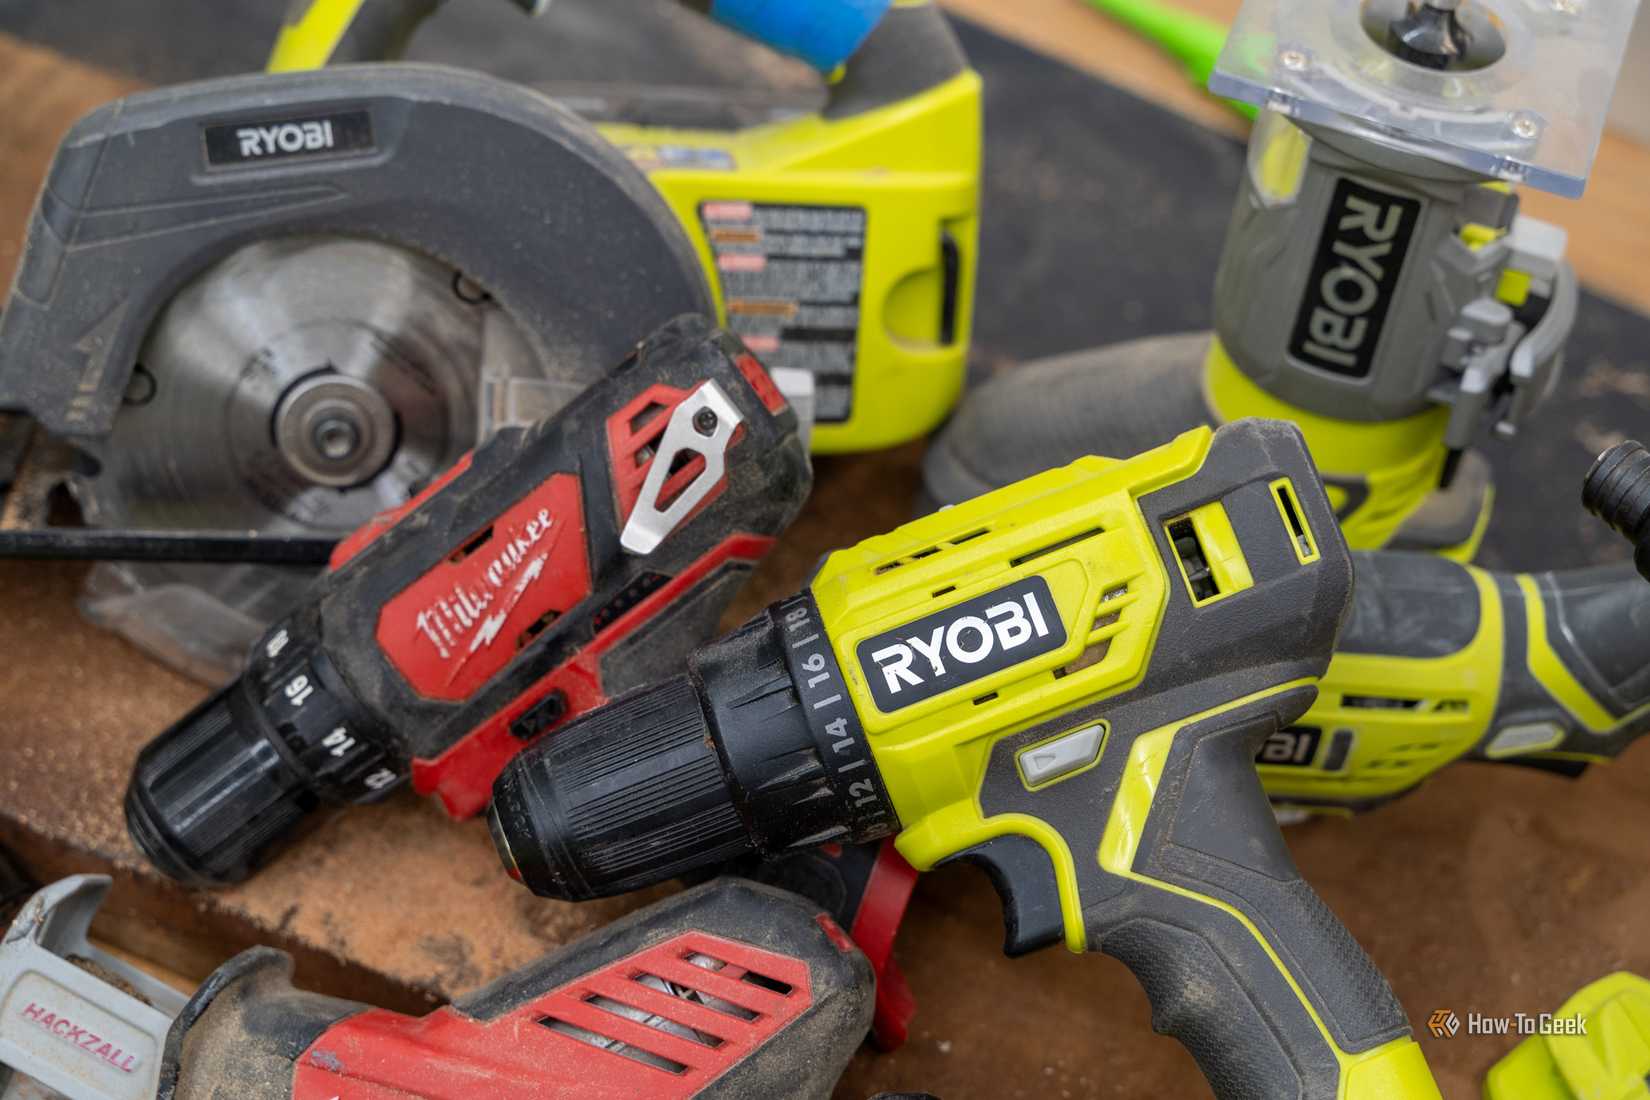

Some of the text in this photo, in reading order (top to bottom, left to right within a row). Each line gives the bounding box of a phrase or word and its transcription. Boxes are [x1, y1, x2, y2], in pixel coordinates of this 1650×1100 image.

[237, 120, 334, 157] RYOBI
[1302, 195, 1403, 367] RYOBI
[785, 606, 810, 633] 18
[871, 591, 1049, 695] RYOBI
[801, 652, 831, 689] 16
[285, 674, 314, 706] 16
[322, 726, 356, 757] 14
[824, 716, 855, 754] 14
[849, 777, 878, 808] 12
[22, 1002, 136, 1073] HACKZALL
